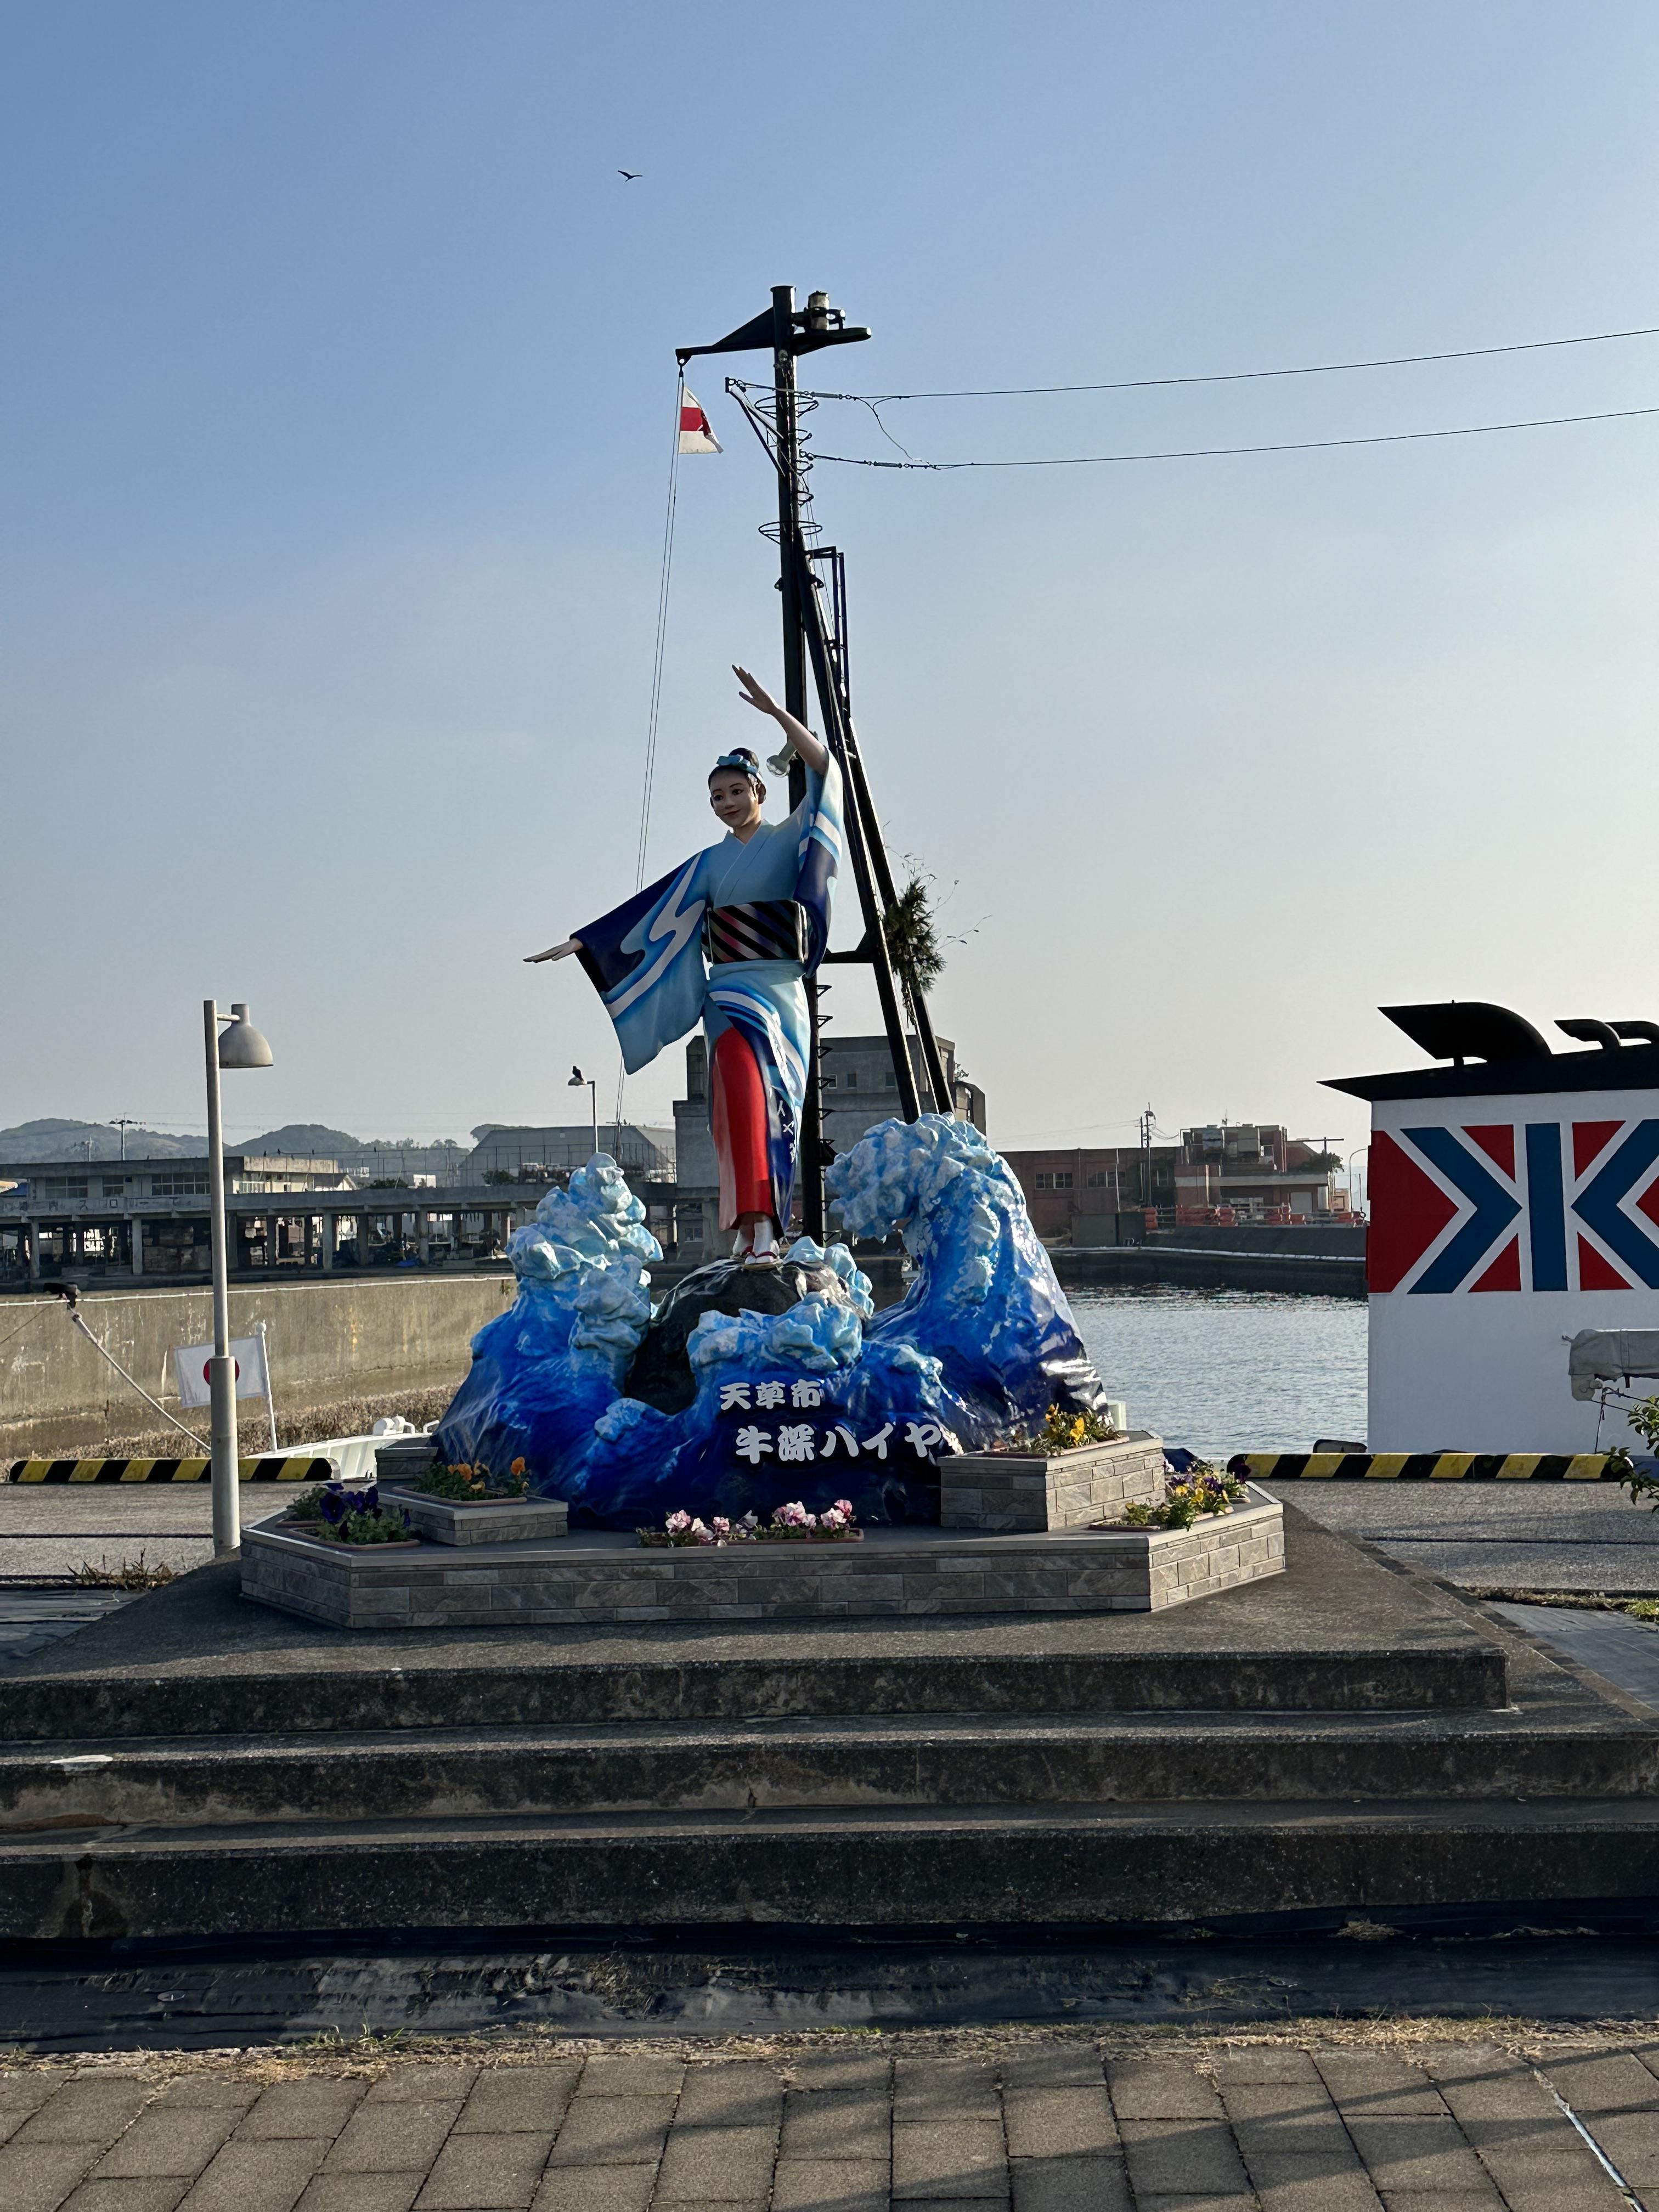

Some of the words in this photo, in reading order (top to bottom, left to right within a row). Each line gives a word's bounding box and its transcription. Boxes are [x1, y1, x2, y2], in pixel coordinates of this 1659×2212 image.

[720, 1379, 821, 1410] 天草市
[736, 1422, 942, 1464] 牛深ハイヤ
